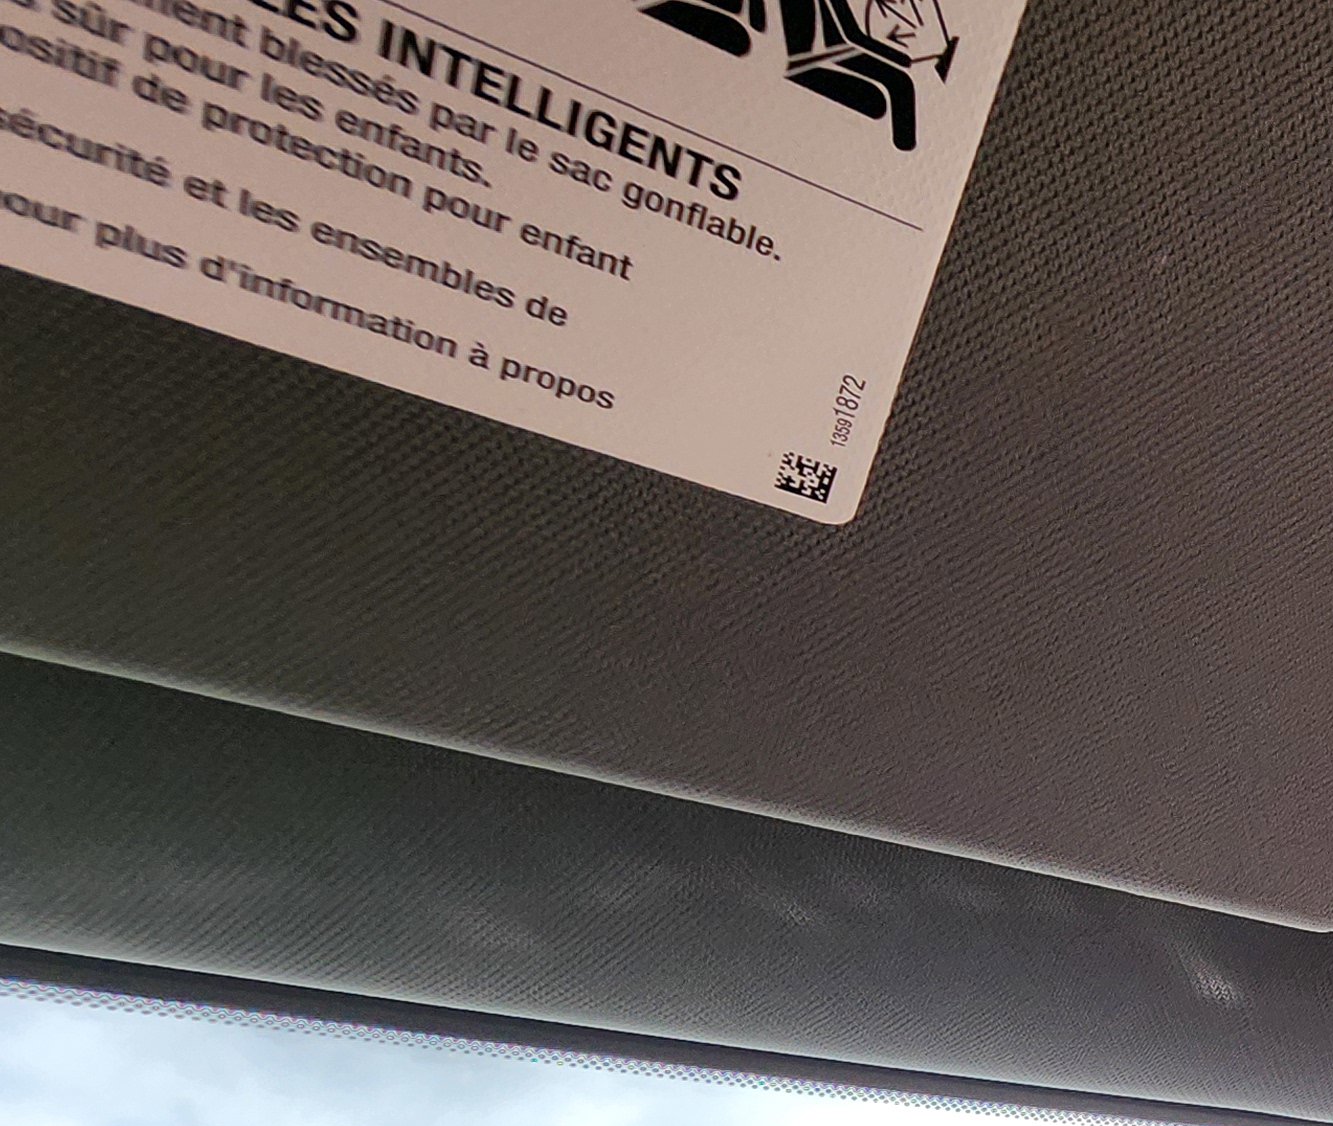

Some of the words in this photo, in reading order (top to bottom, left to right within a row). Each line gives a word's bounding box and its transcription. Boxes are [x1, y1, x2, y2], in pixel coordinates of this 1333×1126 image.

[132, 72, 191, 115] de
[202, 101, 414, 200] protection
[424, 185, 512, 233] pour
[520, 222, 634, 281] enfant
[144, 32, 250, 90] pour
[261, 73, 325, 122] les
[334, 108, 494, 189] enfants.
[259, 25, 419, 116] blessés
[429, 101, 497, 145] par
[505, 126, 541, 163] le
[548, 150, 614, 193] sac
[622, 180, 783, 262] gonflable.
[377, 18, 743, 202] INTELLIGENTS
[94, 220, 190, 270] plus
[199, 253, 459, 358] d'information
[468, 341, 491, 371] à
[500, 354, 616, 411] propos
[183, 175, 229, 209] et
[239, 188, 301, 233] les
[310, 220, 515, 310] ensembles
[525, 296, 568, 327] de
[829, 374, 867, 448] 13591872
